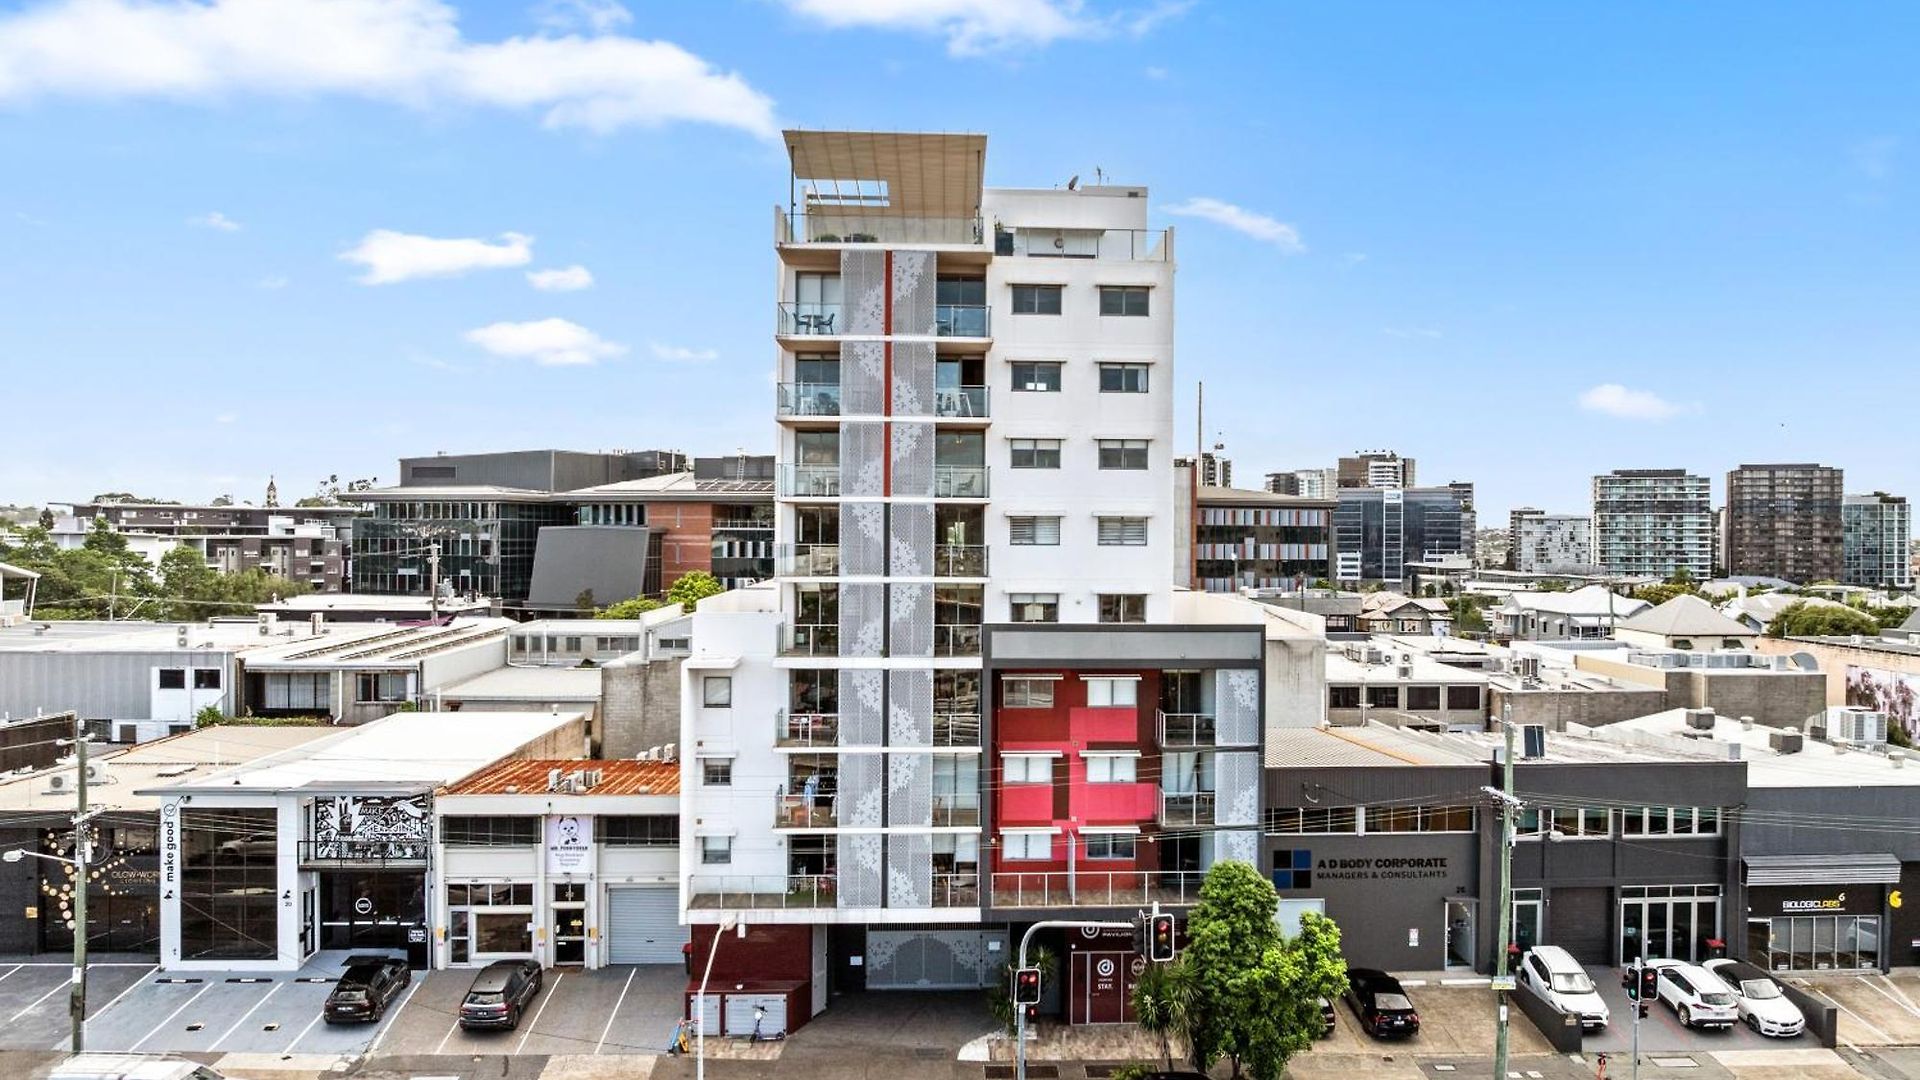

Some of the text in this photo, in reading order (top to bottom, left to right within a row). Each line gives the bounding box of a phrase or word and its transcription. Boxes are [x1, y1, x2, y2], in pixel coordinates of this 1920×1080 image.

[163, 821, 176, 882] make good
[1317, 858, 1448, 869] A D BODY CORPORATE
[1317, 871, 1448, 880] MANAGERS & CONSULTANTS
